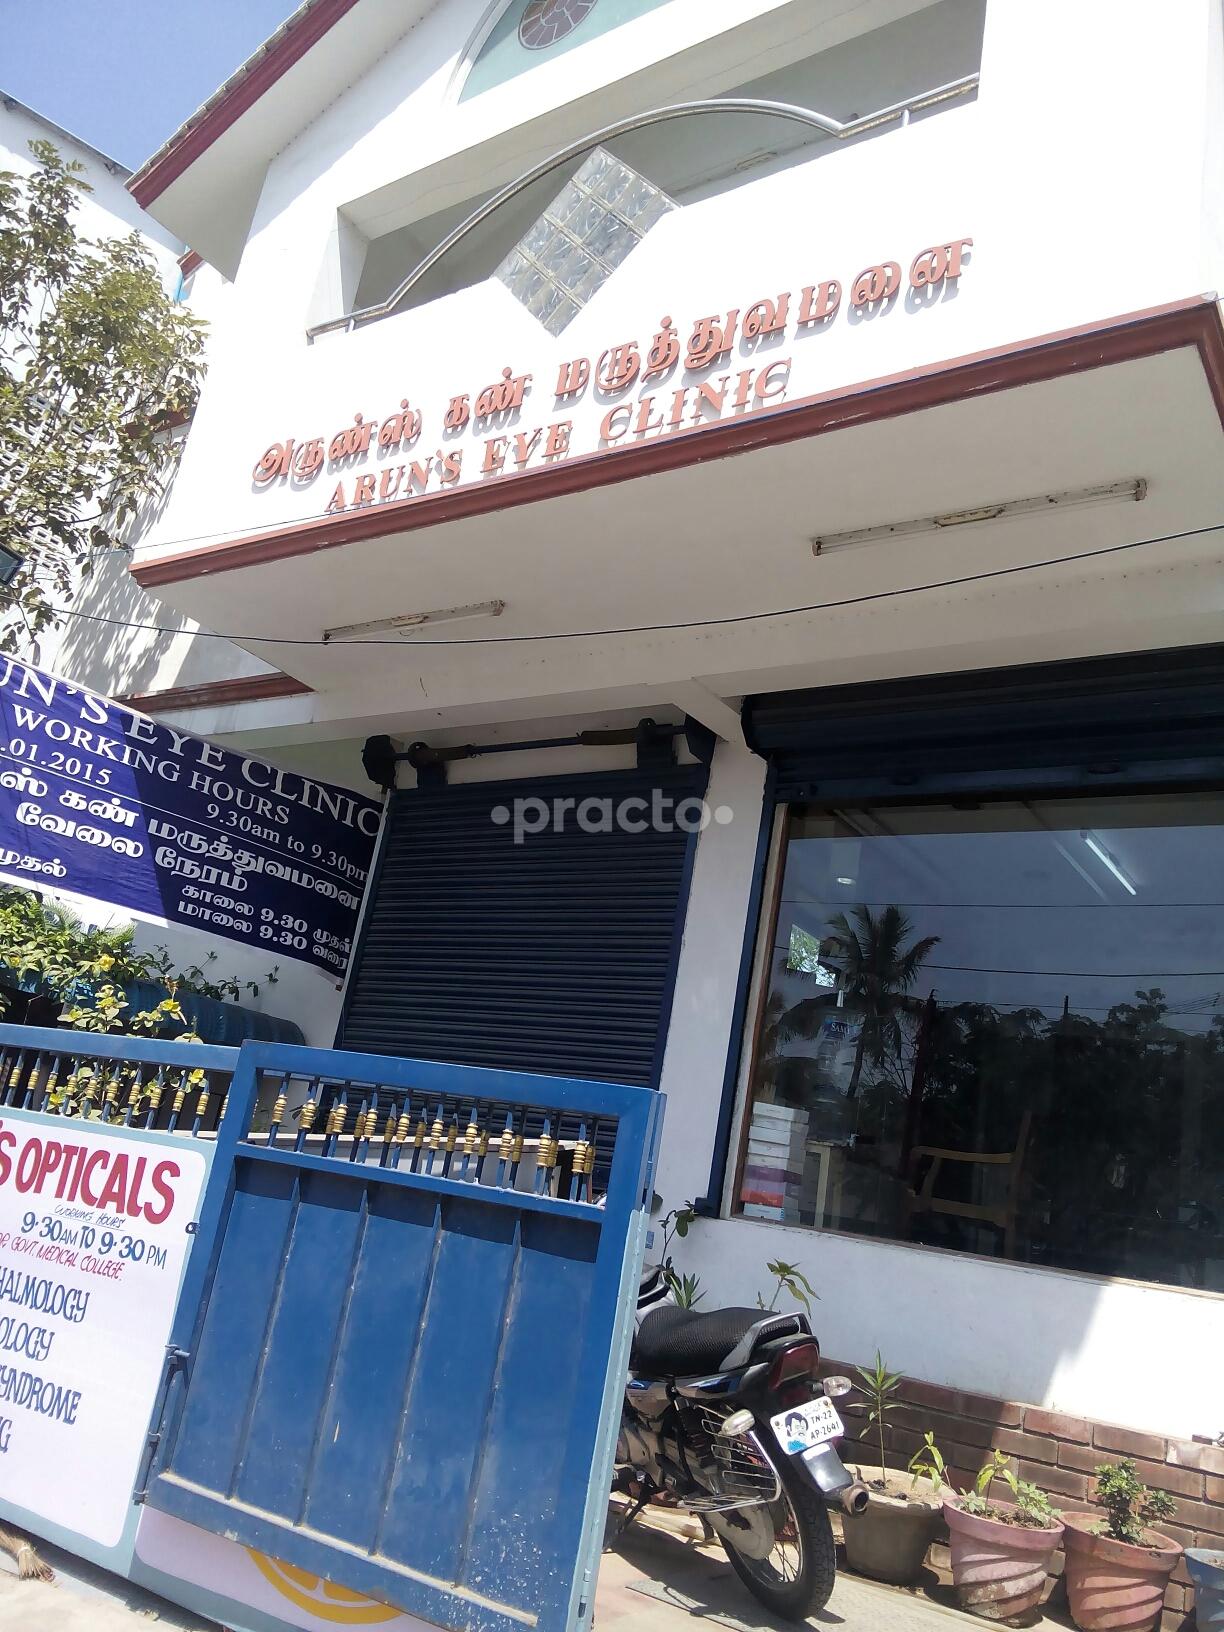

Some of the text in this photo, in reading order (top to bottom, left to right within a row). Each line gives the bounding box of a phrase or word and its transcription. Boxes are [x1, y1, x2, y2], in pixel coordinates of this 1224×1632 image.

[252, 237, 974, 482] அருண்ஸ் கண் மருத்துவமனை
[324, 357, 793, 512] ARUN'S EYE CLINIC
[12, 703, 290, 825] WORKING HOURS
[124, 714, 227, 772] EYE
[241, 758, 384, 837] CLINIC
[16, 802, 248, 892] வேலை நேரம்
[59, 797, 140, 828] கண்
[147, 818, 361, 911] மருத்துவமனை
[205, 803, 281, 844] 9.30am
[287, 834, 305, 853] to
[311, 844, 369, 881] 9.30pm
[177, 900, 253, 933] மாலை
[259, 925, 307, 950] 9.30
[182, 884, 255, 916] காலை
[260, 907, 308, 932] 9.30
[15, 1137, 181, 1225] OPTICALS
[96, 1212, 126, 1228] HOURS
[36, 1244, 80, 1267] MEDICAL
[79, 1225, 96, 1249] TO
